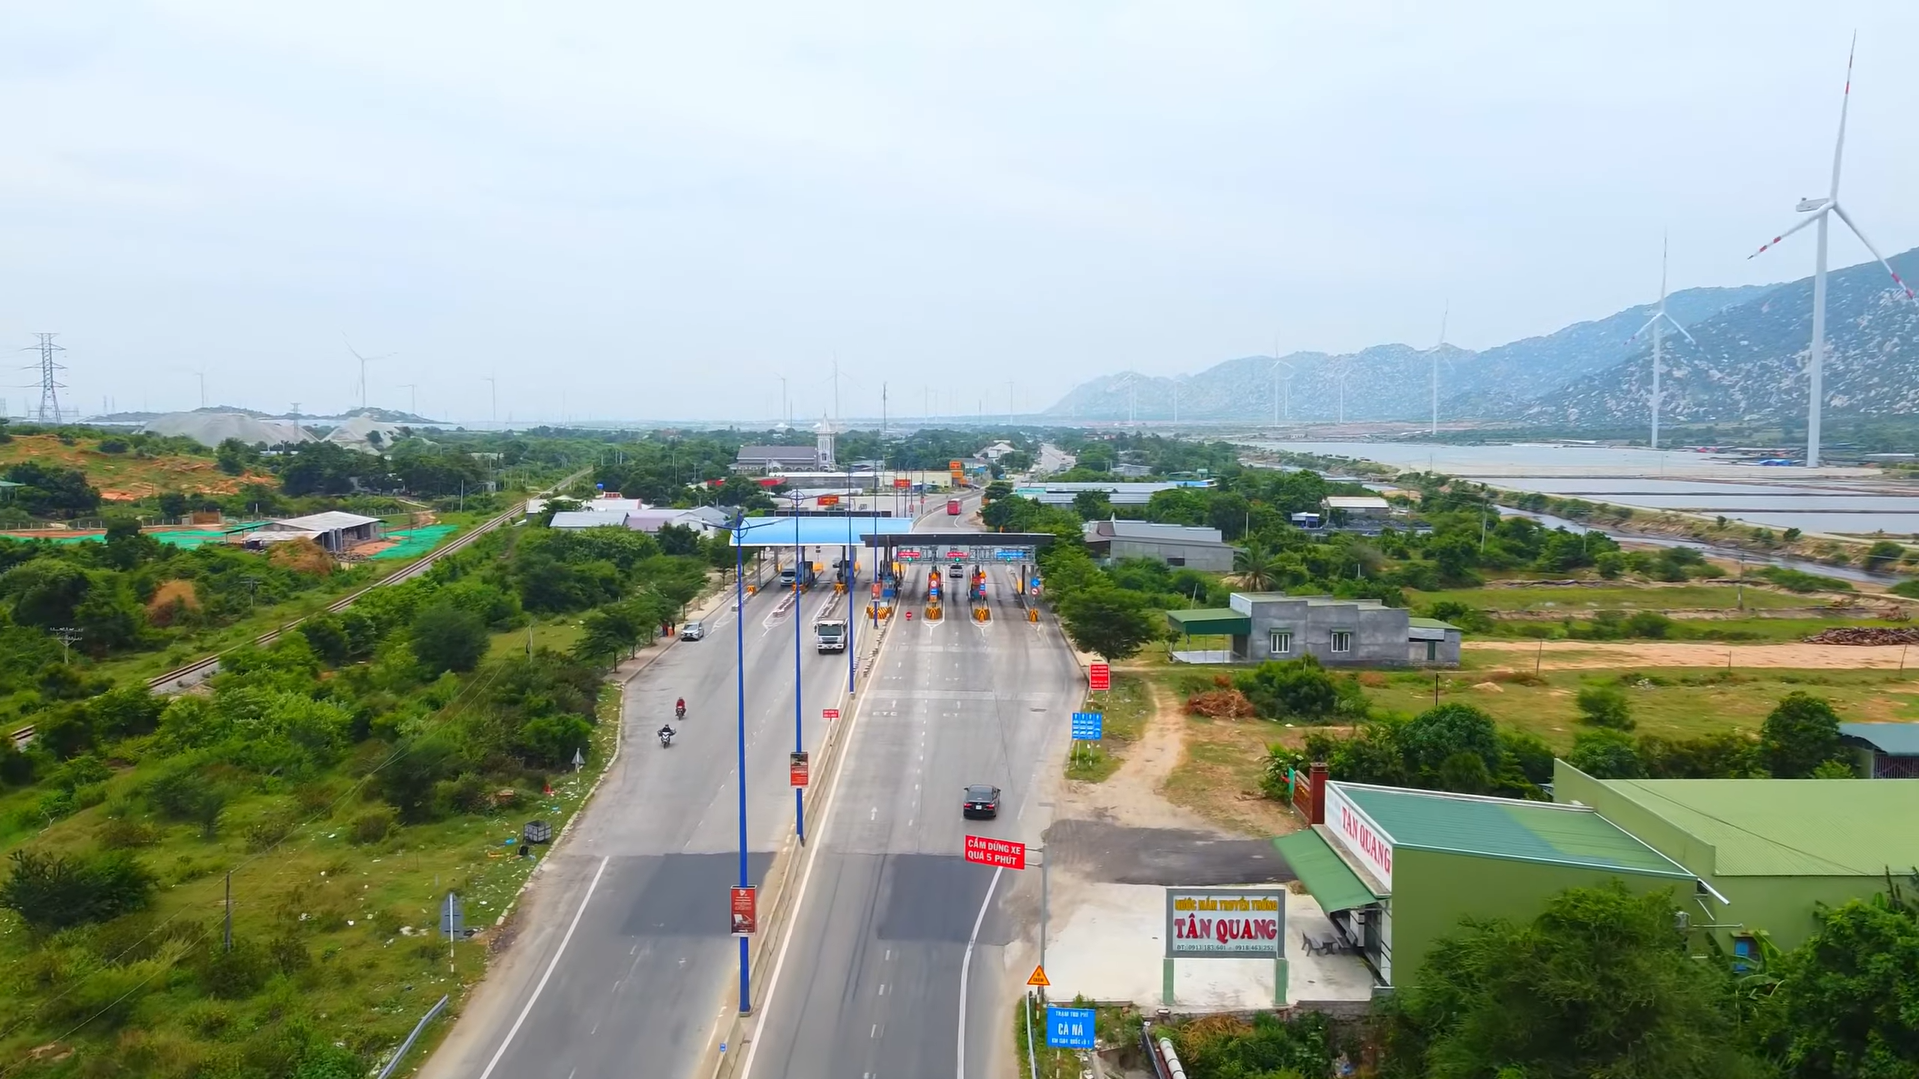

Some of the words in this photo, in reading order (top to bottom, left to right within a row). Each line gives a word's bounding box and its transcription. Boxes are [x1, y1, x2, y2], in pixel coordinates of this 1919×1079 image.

[1010, 845, 1022, 855] XE
[1359, 823, 1392, 874] QUANG
[967, 850, 985, 860] QUÁ
[986, 853, 992, 861] 5
[994, 854, 1017, 865] PHÚT
[1174, 912, 1212, 939] TÂN
[1216, 918, 1278, 944] QUANG
[1058, 1021, 1069, 1036] CÀ
[1071, 1022, 1083, 1036] NÁ
